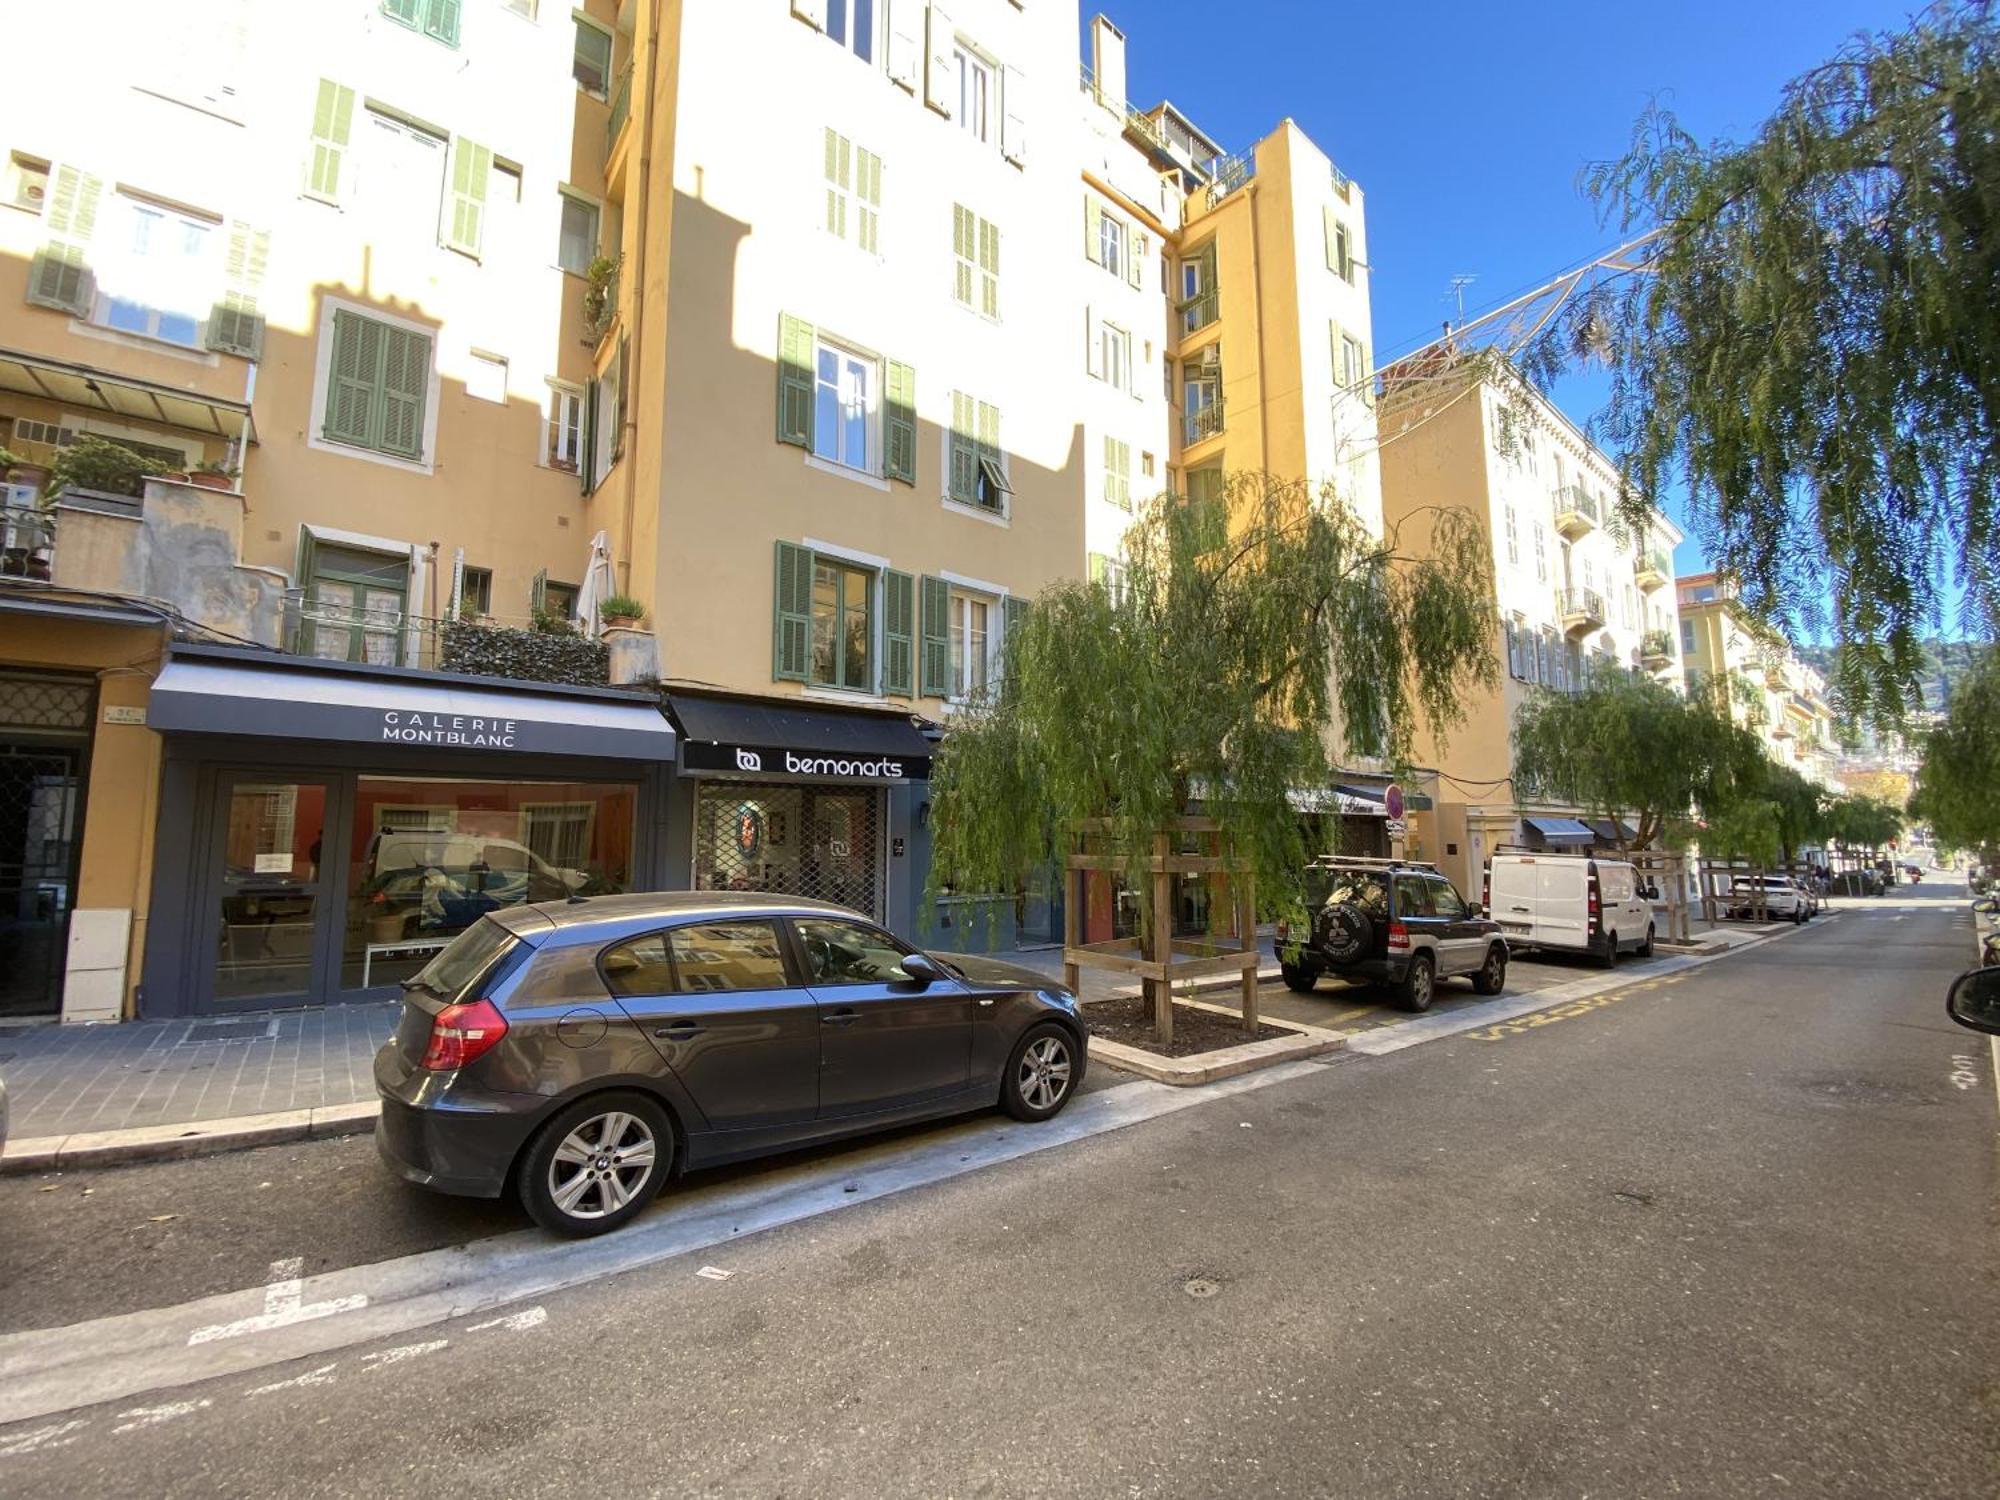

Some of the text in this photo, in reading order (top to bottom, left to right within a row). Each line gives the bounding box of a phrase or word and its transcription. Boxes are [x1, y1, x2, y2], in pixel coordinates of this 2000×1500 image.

[384, 711, 517, 733] GALERIE
[383, 727, 515, 748] MONTBLANC
[786, 751, 902, 777] bemonarts
